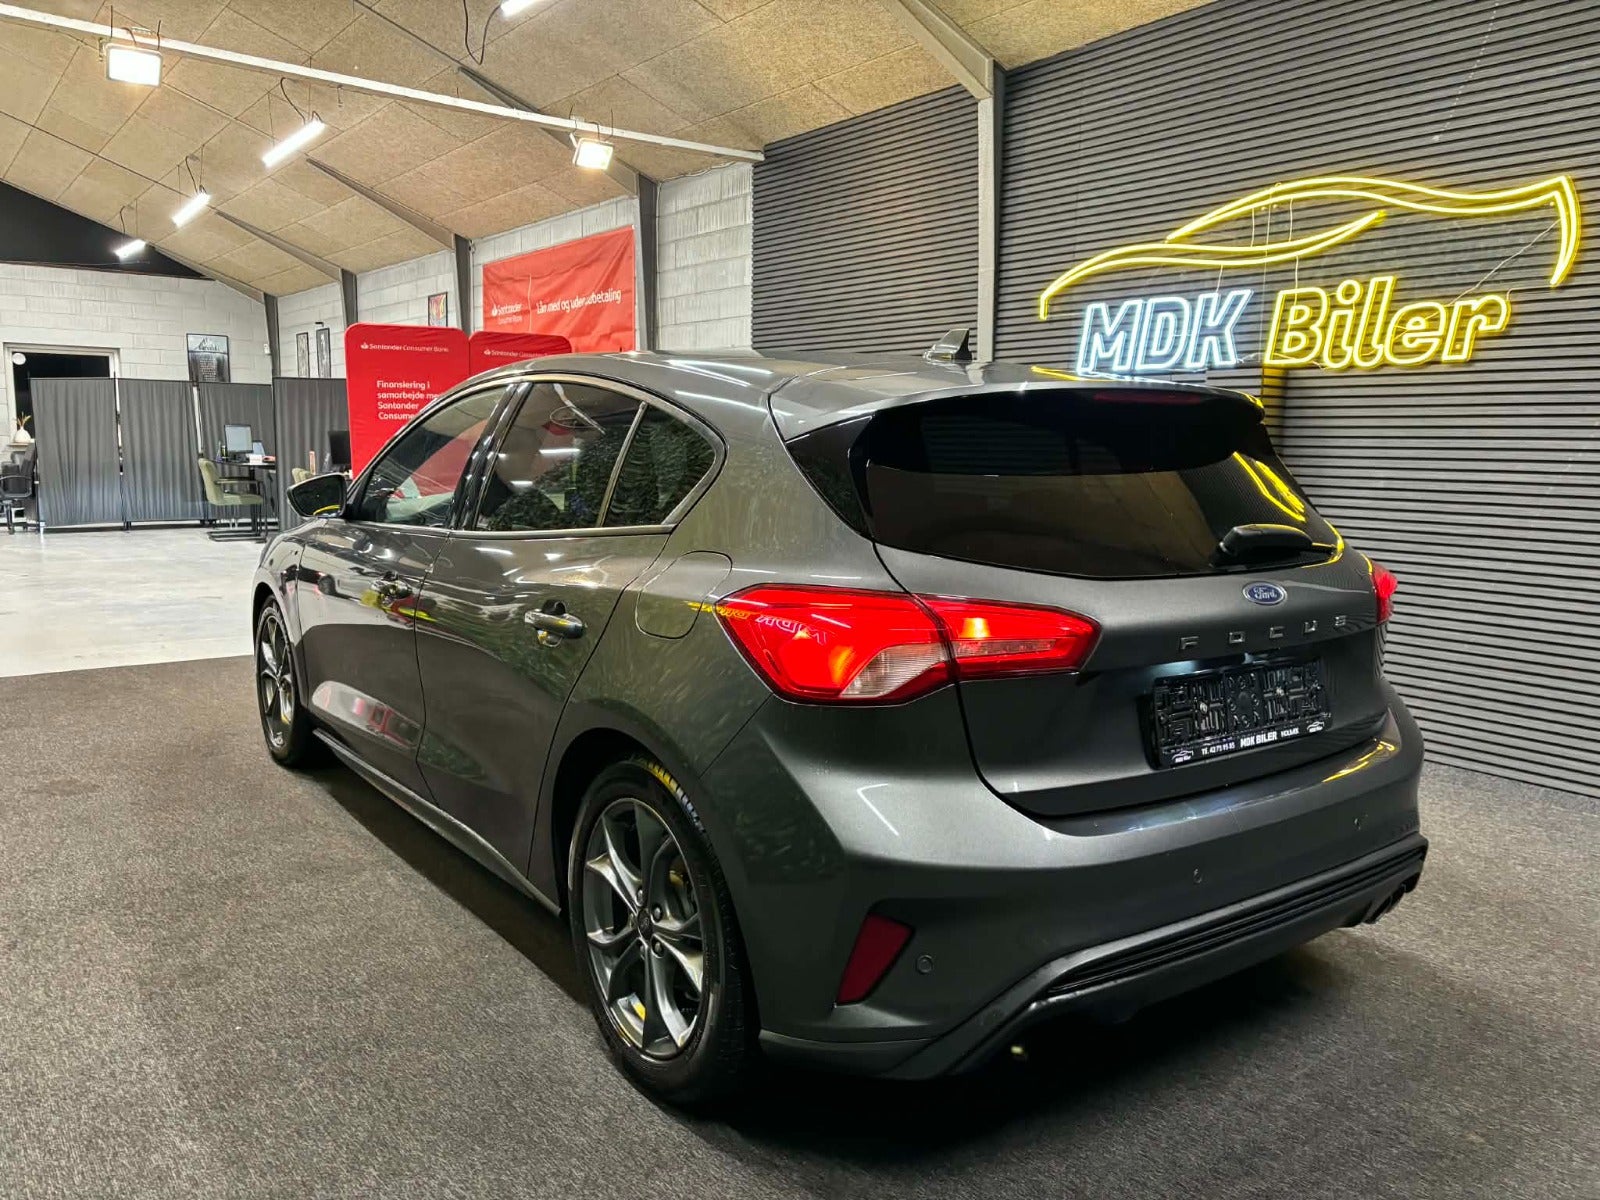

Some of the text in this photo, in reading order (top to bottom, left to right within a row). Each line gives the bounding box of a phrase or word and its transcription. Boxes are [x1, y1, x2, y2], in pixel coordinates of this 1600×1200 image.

[1076, 275, 1511, 375] MDK Biler
[369, 343, 402, 351] Santander
[402, 344, 432, 352] Consumer
[376, 380, 426, 390] Finansiering
[377, 391, 441, 400] samarbejde me
[378, 401, 419, 409] Santander
[378, 411, 416, 420] Consume
[1252, 586, 1279, 600] Ford
[1179, 614, 1348, 651] FOCUS
[1240, 735, 1255, 748] MDK
[1255, 730, 1278, 744] BILER
